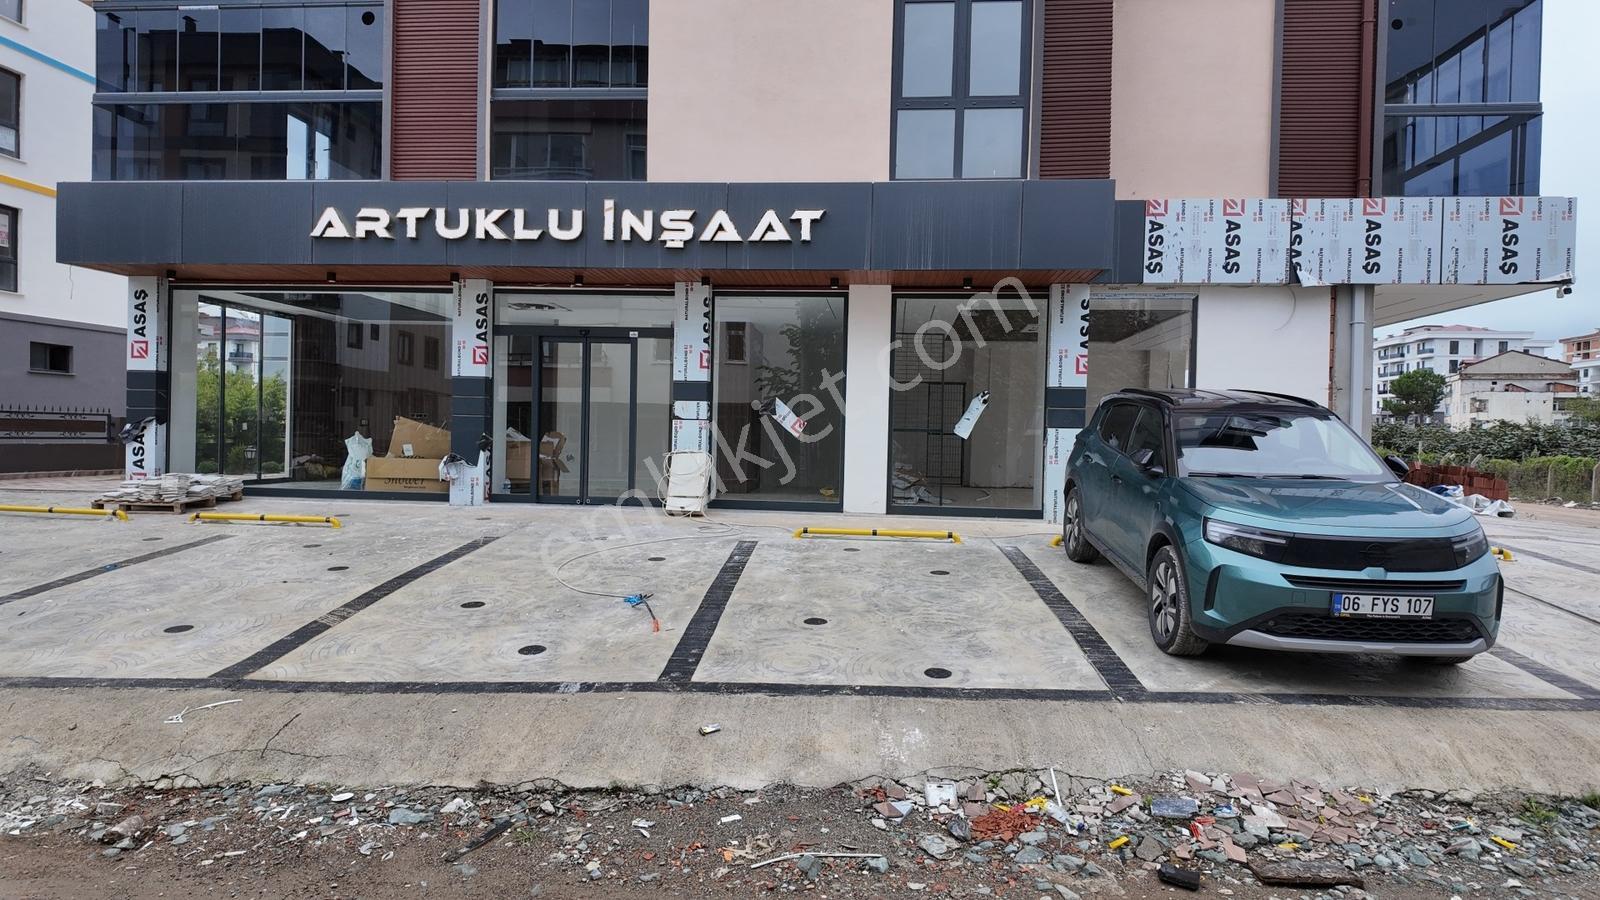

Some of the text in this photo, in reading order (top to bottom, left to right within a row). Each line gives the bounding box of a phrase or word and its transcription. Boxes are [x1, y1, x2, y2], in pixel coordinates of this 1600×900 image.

[310, 199, 827, 248] ARTUKLU İNŞAAT
[1145, 219, 1164, 274] ASAŞ
[1222, 219, 1242, 274] ASAŞ
[1362, 218, 1382, 275] ASAŞ
[1499, 218, 1519, 275] ASAŞ
[133, 288, 149, 338] ASAŞ
[132, 426, 147, 470] ASA
[1342, 596, 1432, 614] 06 FYS 107
